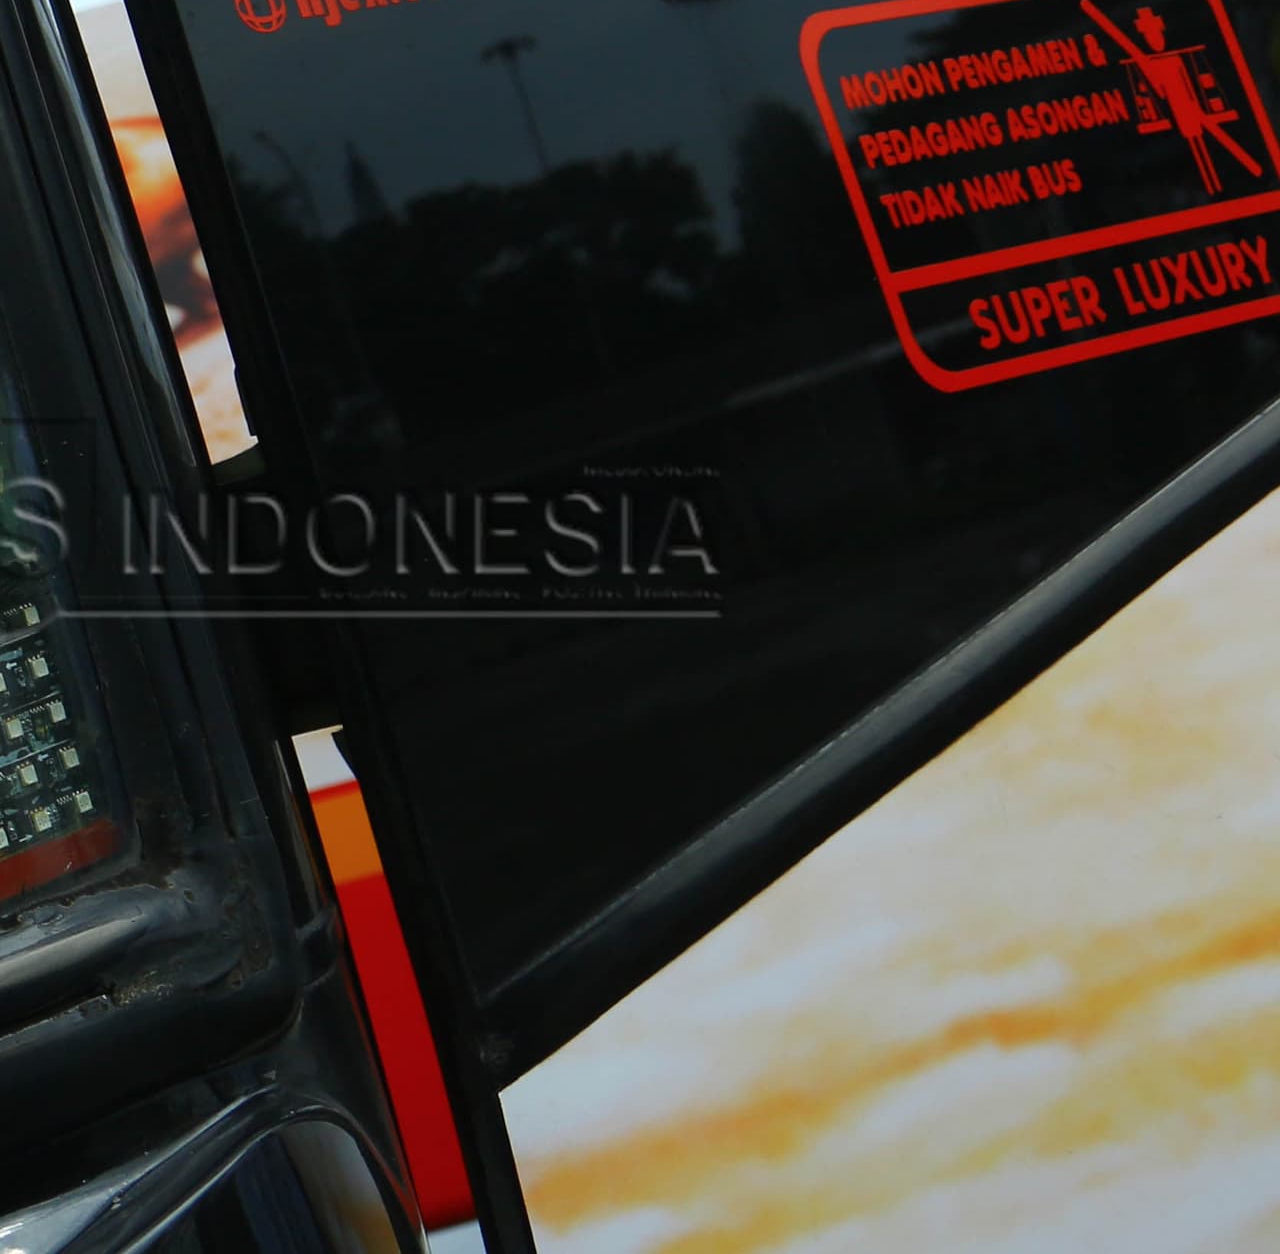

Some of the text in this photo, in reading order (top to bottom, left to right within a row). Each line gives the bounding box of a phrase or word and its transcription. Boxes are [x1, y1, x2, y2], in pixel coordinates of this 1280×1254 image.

[841, 33, 1107, 109] MOHON PENGAMEN &
[859, 90, 1129, 168] PEDAGANG ASONGAN
[880, 159, 1082, 228] TIDAK NAIK BUS
[968, 235, 1273, 350] SUPER LUXURY
